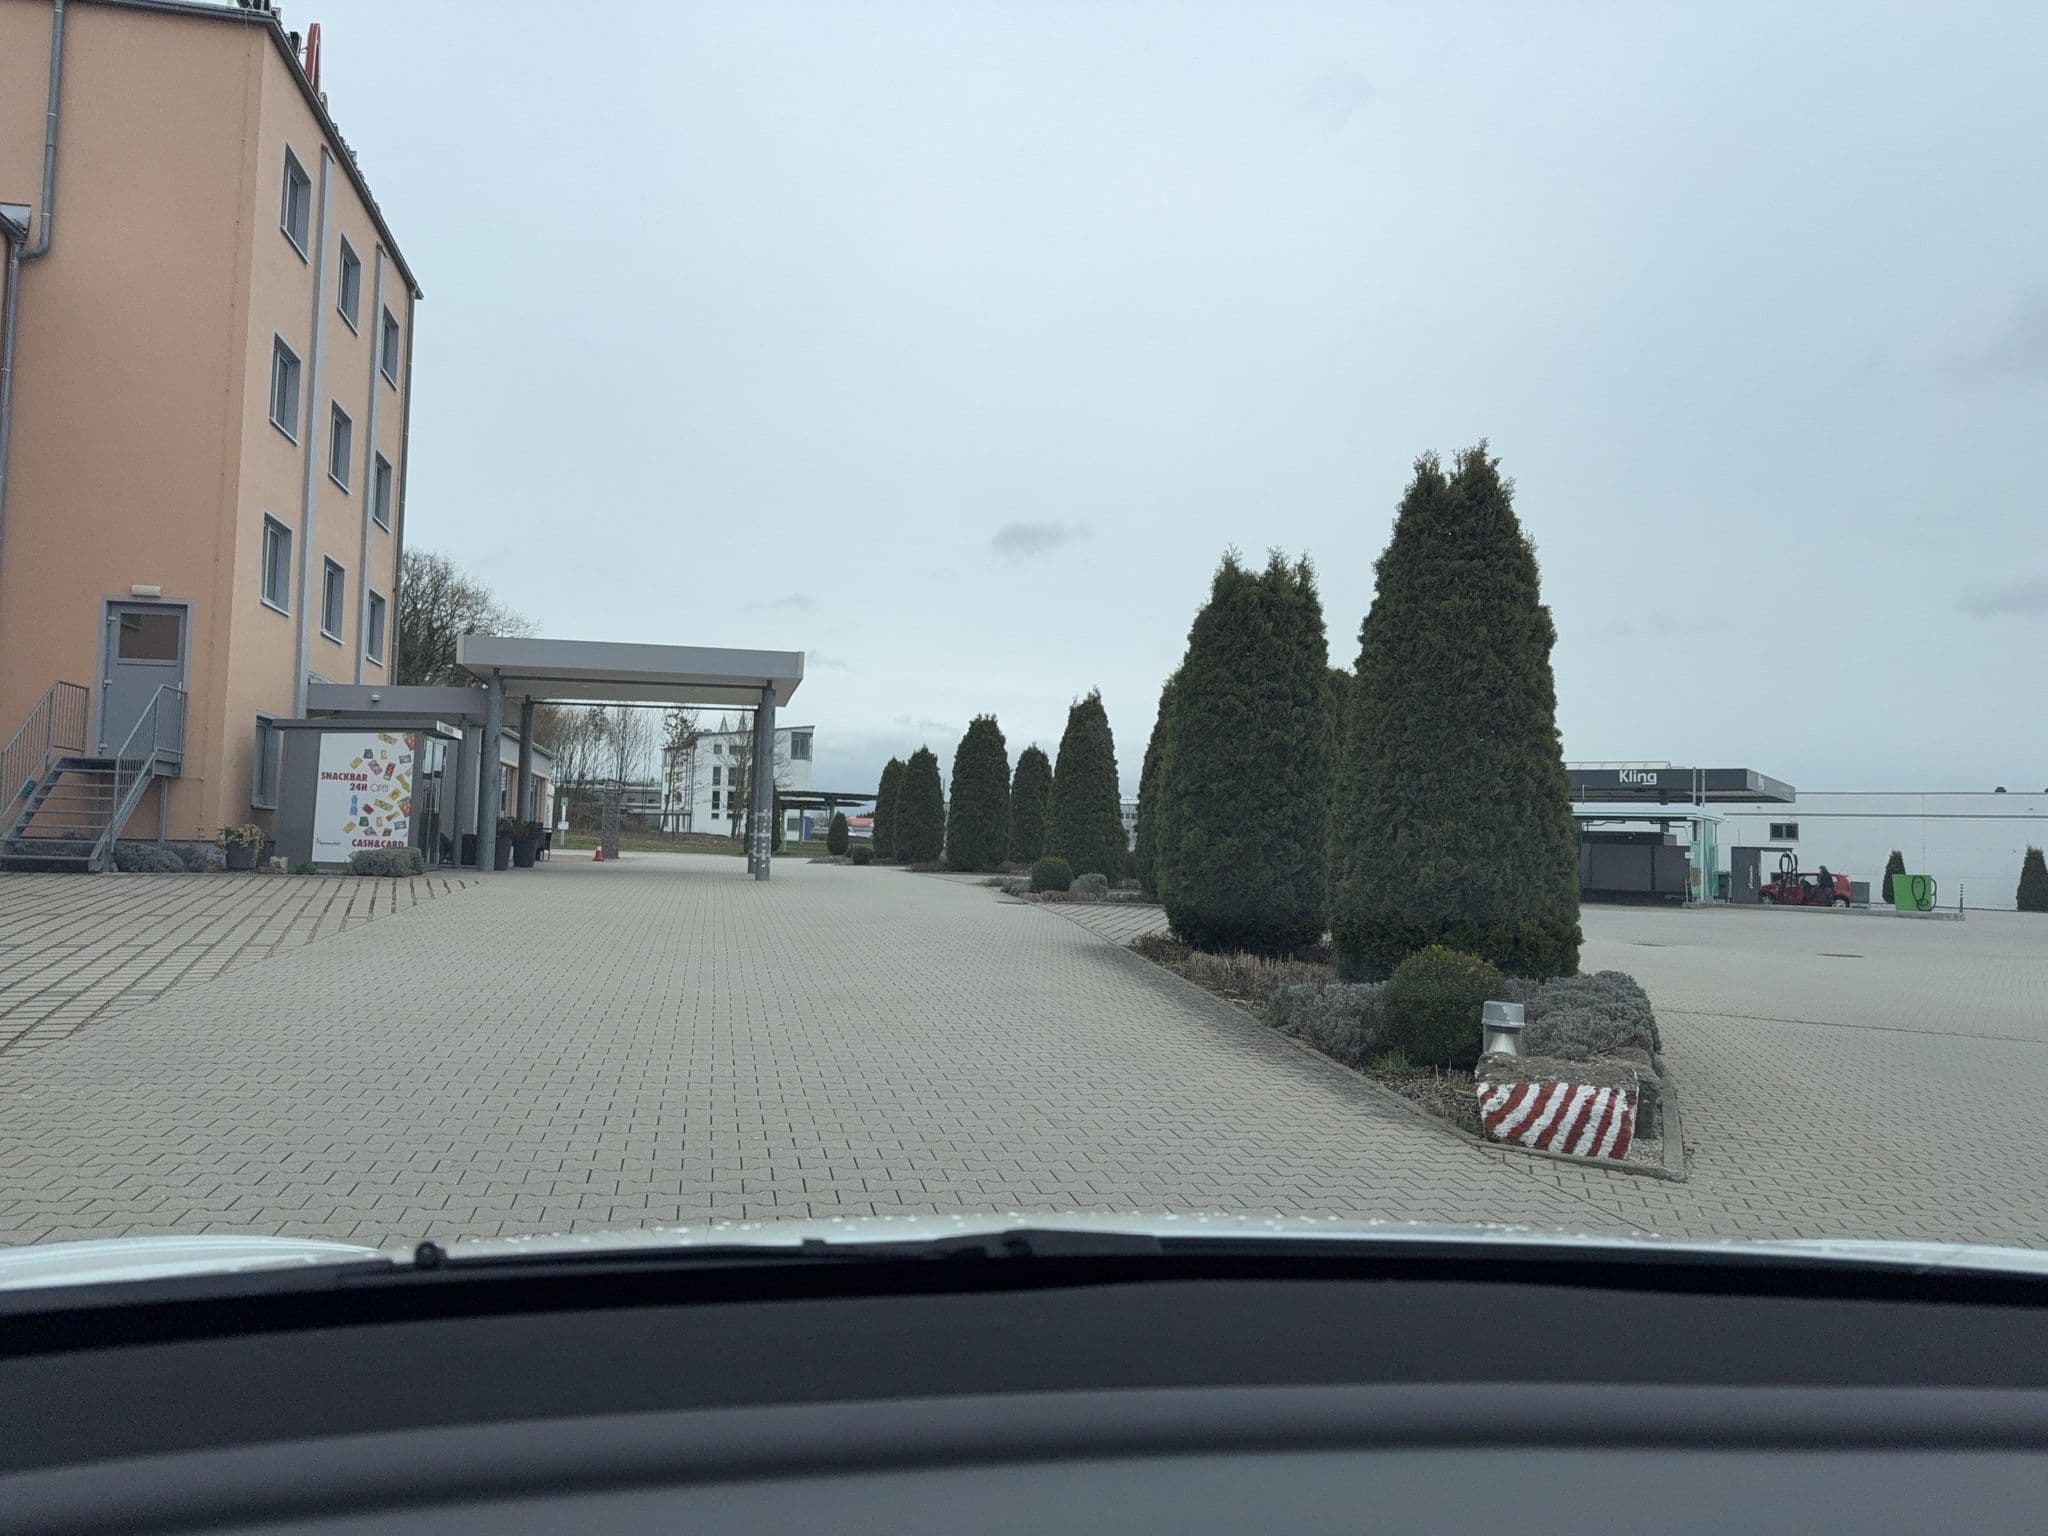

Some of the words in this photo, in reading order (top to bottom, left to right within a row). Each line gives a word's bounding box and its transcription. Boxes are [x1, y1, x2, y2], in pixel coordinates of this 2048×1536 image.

[321, 772, 368, 781] SNACKBAR
[1619, 770, 1657, 785] Kling
[350, 783, 368, 791] 24H
[351, 838, 405, 848] CASH&CARD
